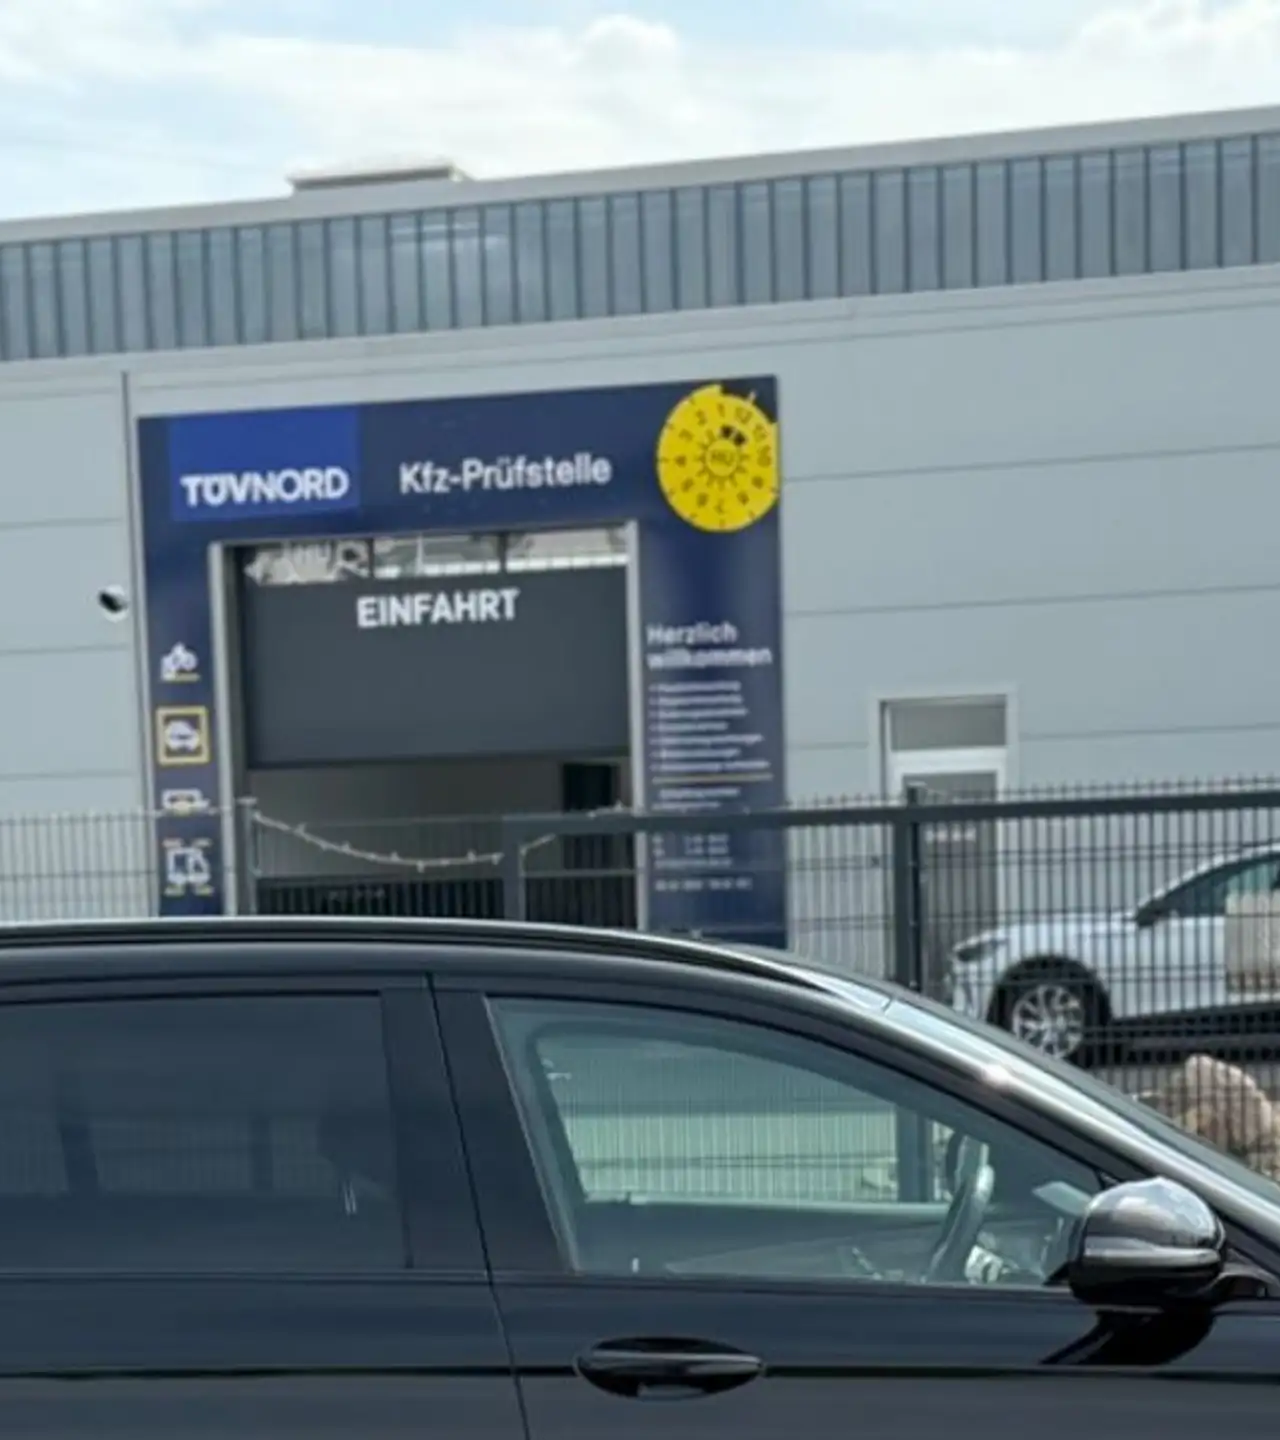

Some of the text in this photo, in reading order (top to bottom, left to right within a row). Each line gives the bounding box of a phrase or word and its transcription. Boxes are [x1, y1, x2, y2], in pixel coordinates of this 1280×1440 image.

[398, 453, 612, 494] Kfz-Prüfstelle
[357, 586, 521, 629] EINFAHRT
[646, 621, 738, 645] Herzlich
